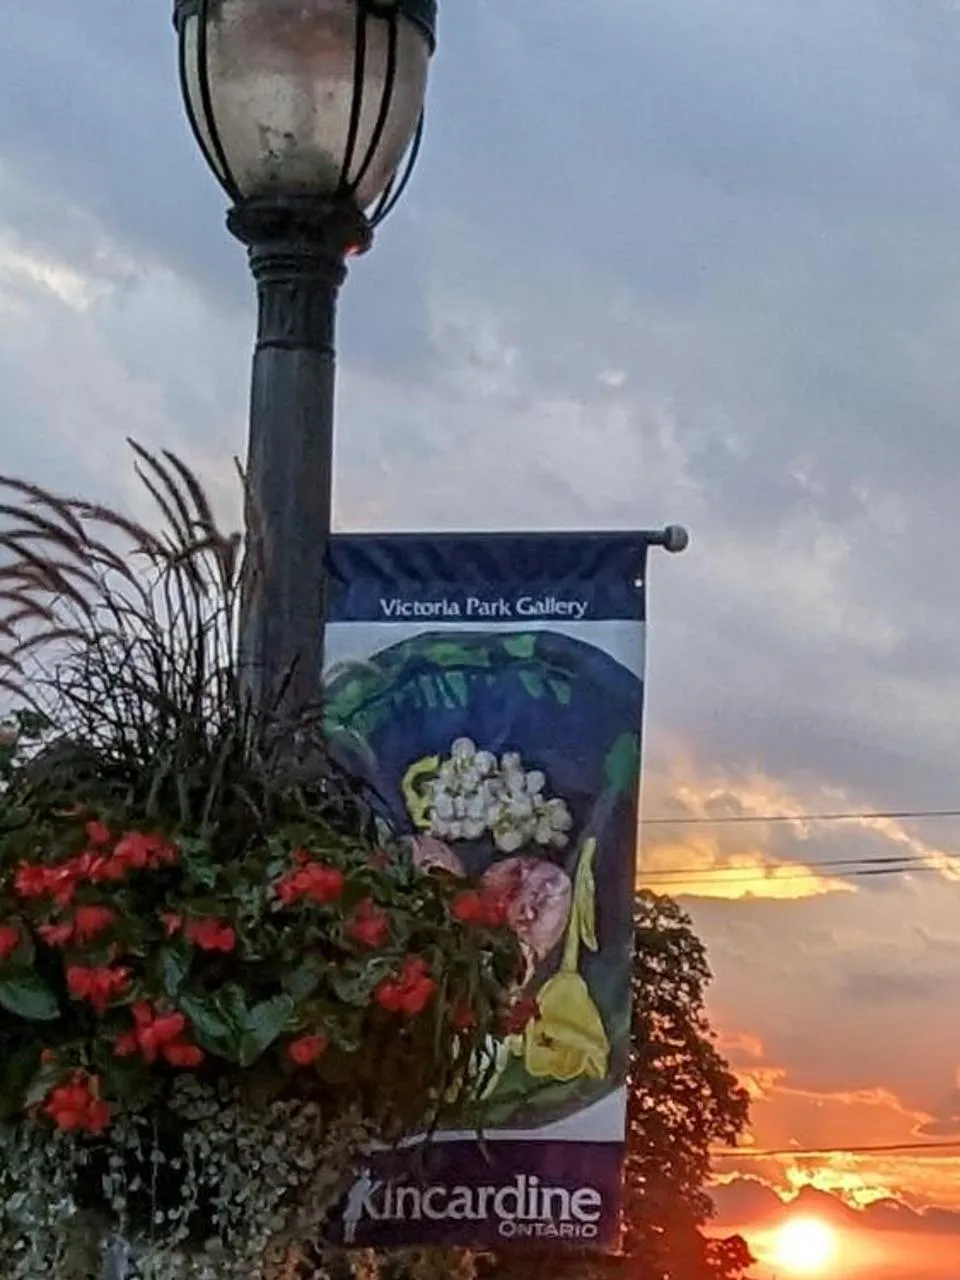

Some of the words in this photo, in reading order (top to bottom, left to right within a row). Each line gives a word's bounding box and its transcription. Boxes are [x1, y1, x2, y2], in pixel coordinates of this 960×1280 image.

[380, 597, 460, 617] Victoria
[466, 597, 512, 616] Park
[516, 596, 588, 620] Gallery
[343, 1171, 601, 1226] Kincardine
